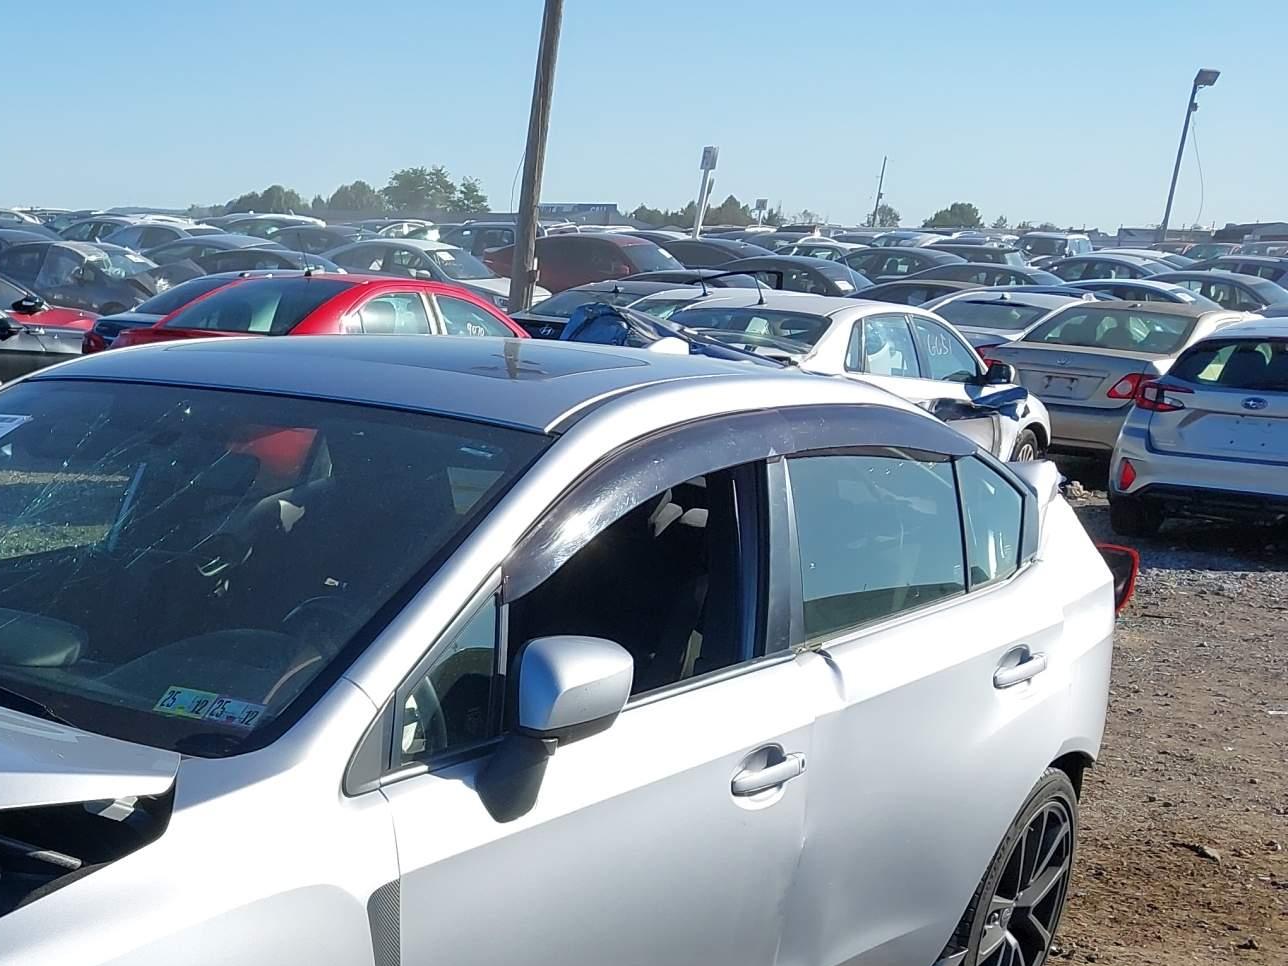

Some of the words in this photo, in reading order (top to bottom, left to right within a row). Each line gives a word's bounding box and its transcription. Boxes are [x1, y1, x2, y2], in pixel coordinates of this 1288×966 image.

[160, 690, 182, 707] 25
[191, 699, 209, 714] 12
[209, 700, 231, 718] 25
[240, 710, 259, 725] 12
